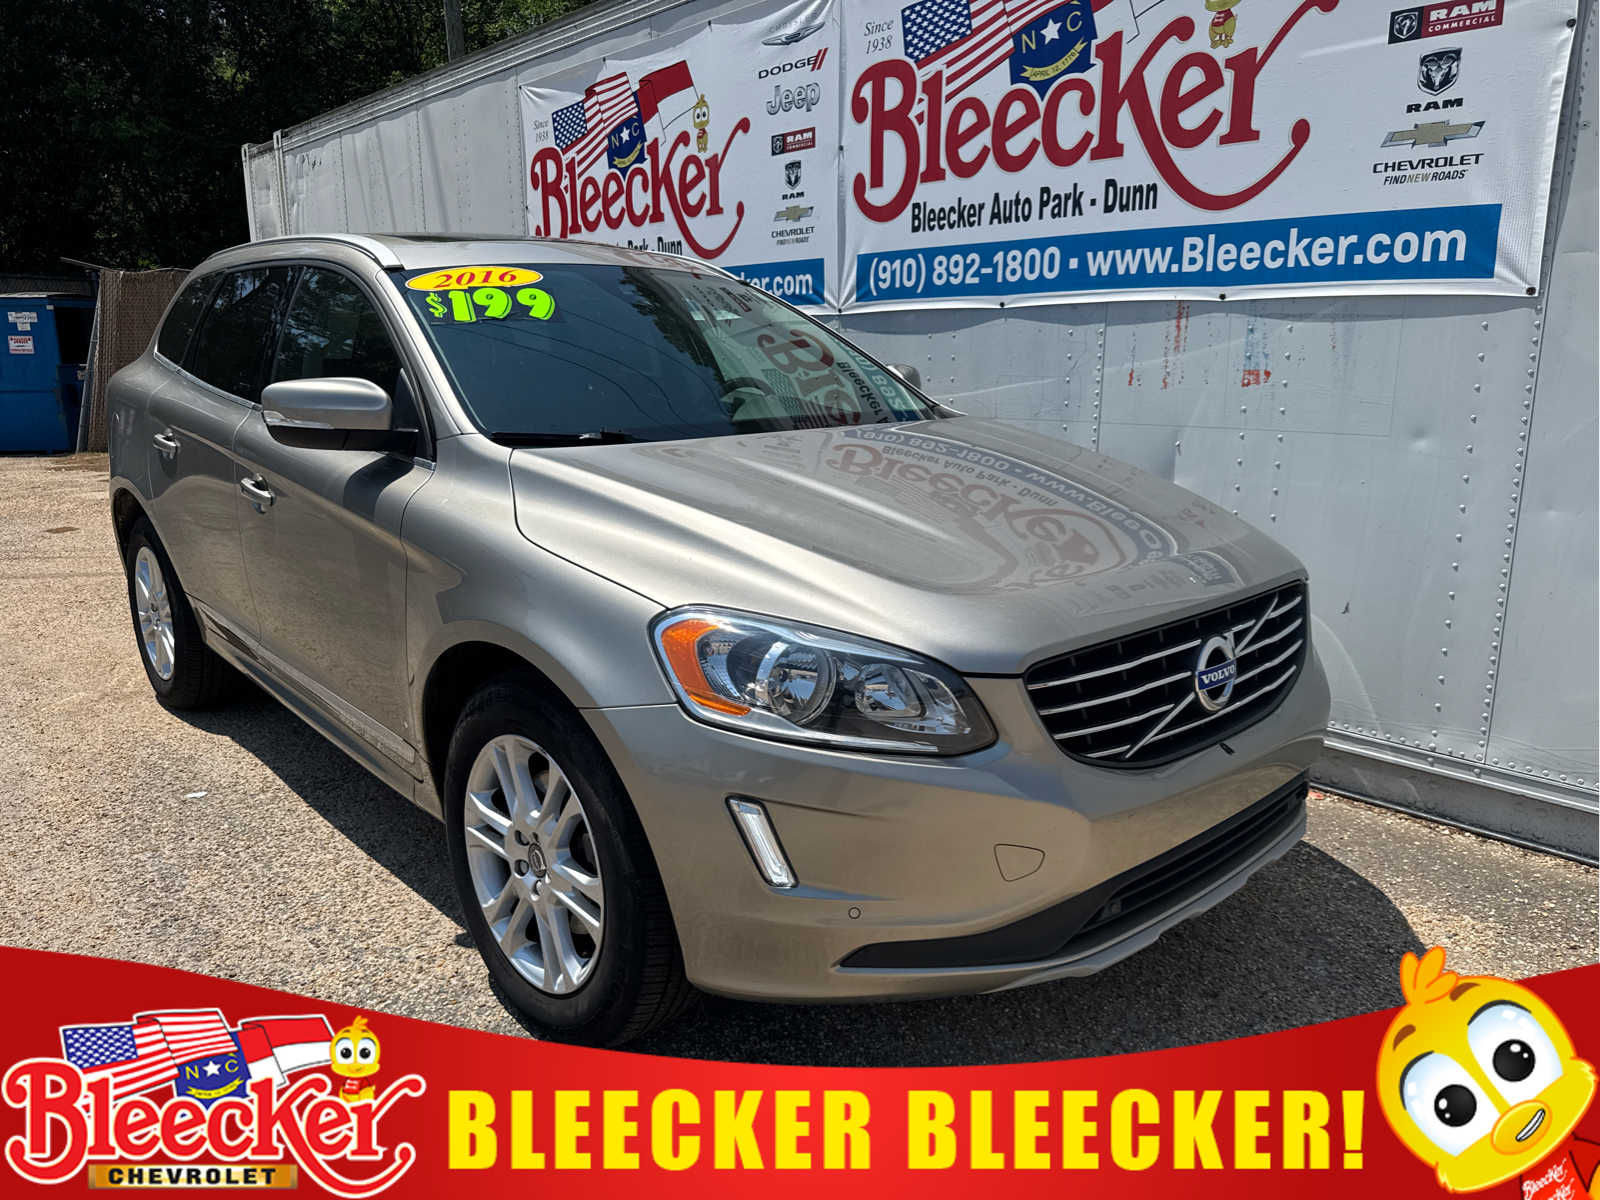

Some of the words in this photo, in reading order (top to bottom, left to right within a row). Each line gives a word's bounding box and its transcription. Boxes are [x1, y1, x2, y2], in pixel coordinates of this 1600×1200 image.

[1429, 0, 1496, 21] RAM
[864, 19, 894, 37] Since
[1428, 15, 1496, 32] COMMERCIAL
[865, 36, 893, 55] 1938
[758, 55, 818, 79] DODGE
[766, 83, 820, 115] Jeep
[1406, 98, 1464, 114] RAM
[851, 0, 1340, 223] Bleecker
[786, 131, 813, 143] RAM
[1372, 153, 1484, 174] CHEVROLET
[530, 117, 751, 260] Bleecker
[782, 192, 805, 201] RAM
[911, 202, 985, 233] Bleecker
[989, 191, 1032, 226] Auto
[1038, 185, 1084, 220] Park
[1103, 179, 1158, 213] Dunn
[771, 226, 815, 238] CHEVROLET
[869, 254, 926, 294] (910)
[933, 246, 1060, 285] 892-1800
[1087, 229, 1467, 277] www.Bleecker.com
[434, 269, 517, 289] 2016
[425, 287, 556, 322] $199
[1200, 664, 1236, 684] VOLVO
